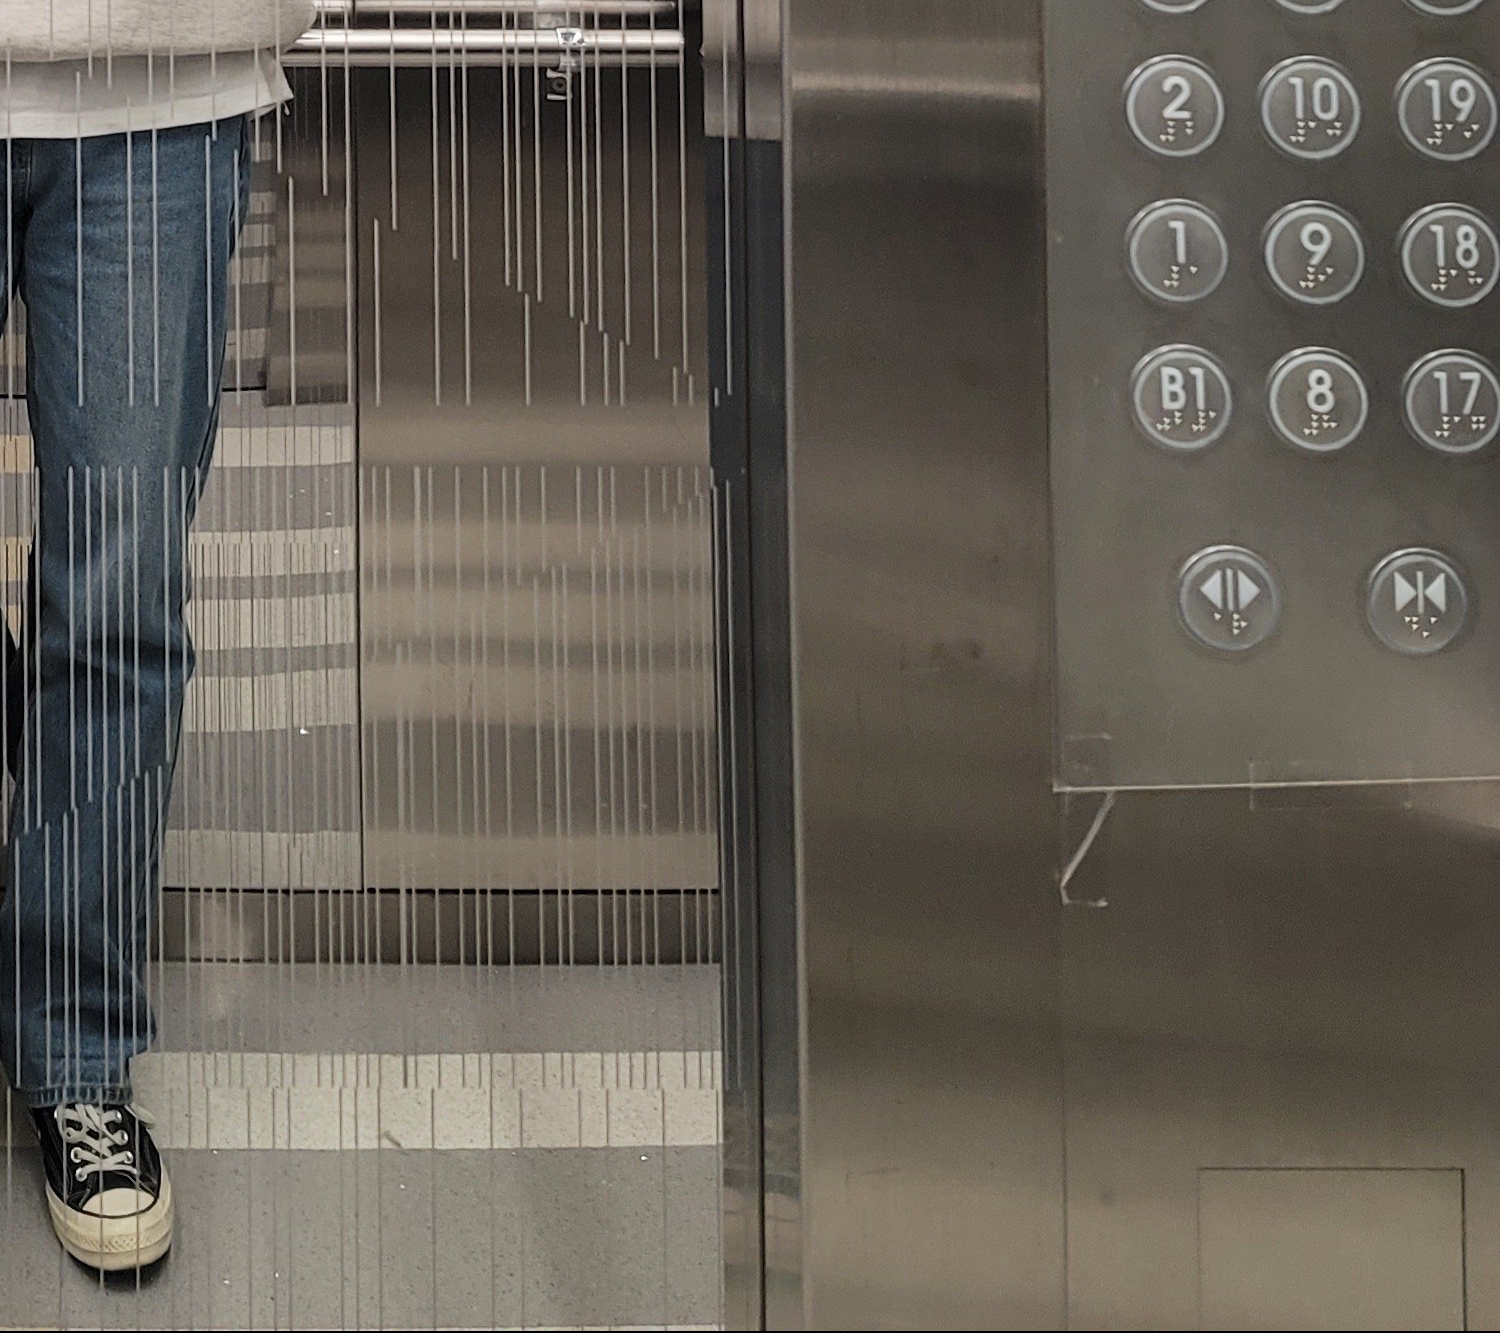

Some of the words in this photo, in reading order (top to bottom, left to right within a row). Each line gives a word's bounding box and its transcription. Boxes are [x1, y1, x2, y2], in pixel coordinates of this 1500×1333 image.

[1161, 76, 1192, 119] 2
[1288, 77, 1339, 121] 10
[1425, 78, 1476, 122] 19
[1167, 220, 1186, 265] 1
[1300, 221, 1332, 267] 9
[1429, 224, 1480, 269] 18
[1160, 367, 1206, 411] B1
[1306, 368, 1335, 414] 8
[1434, 372, 1482, 415] 17
